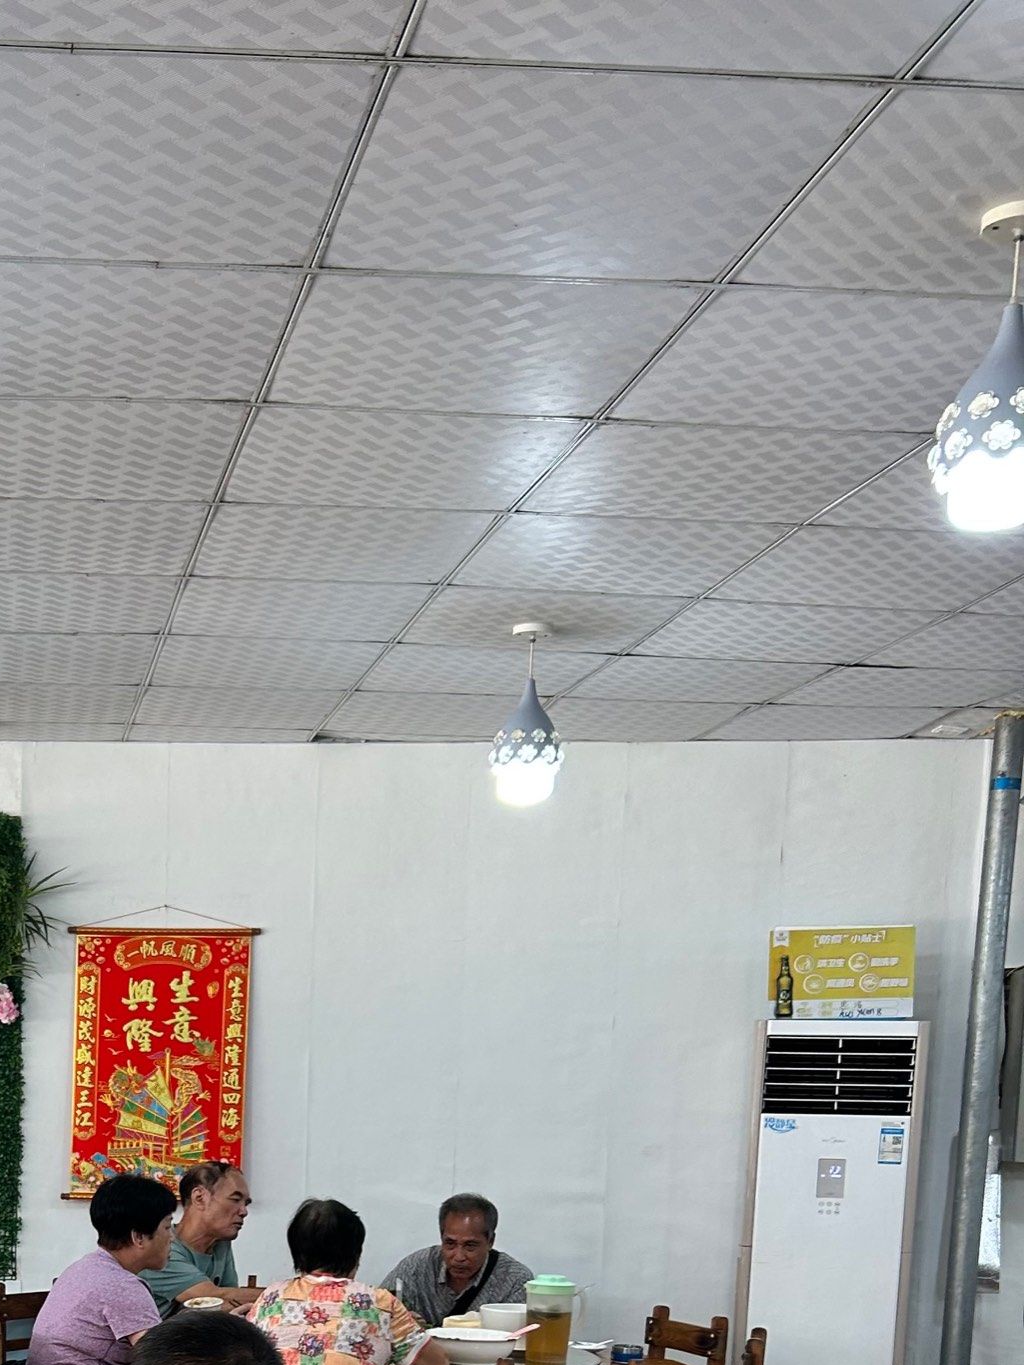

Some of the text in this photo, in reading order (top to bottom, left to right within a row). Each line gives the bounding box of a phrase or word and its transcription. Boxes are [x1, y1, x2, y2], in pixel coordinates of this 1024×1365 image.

[126, 940, 196, 964] 一帆風順
[121, 977, 164, 1053] 興隆
[162, 970, 201, 1044] 生意
[75, 975, 97, 1128] 財源茂盛達三江
[221, 976, 245, 1130] 生意興隆通四海
